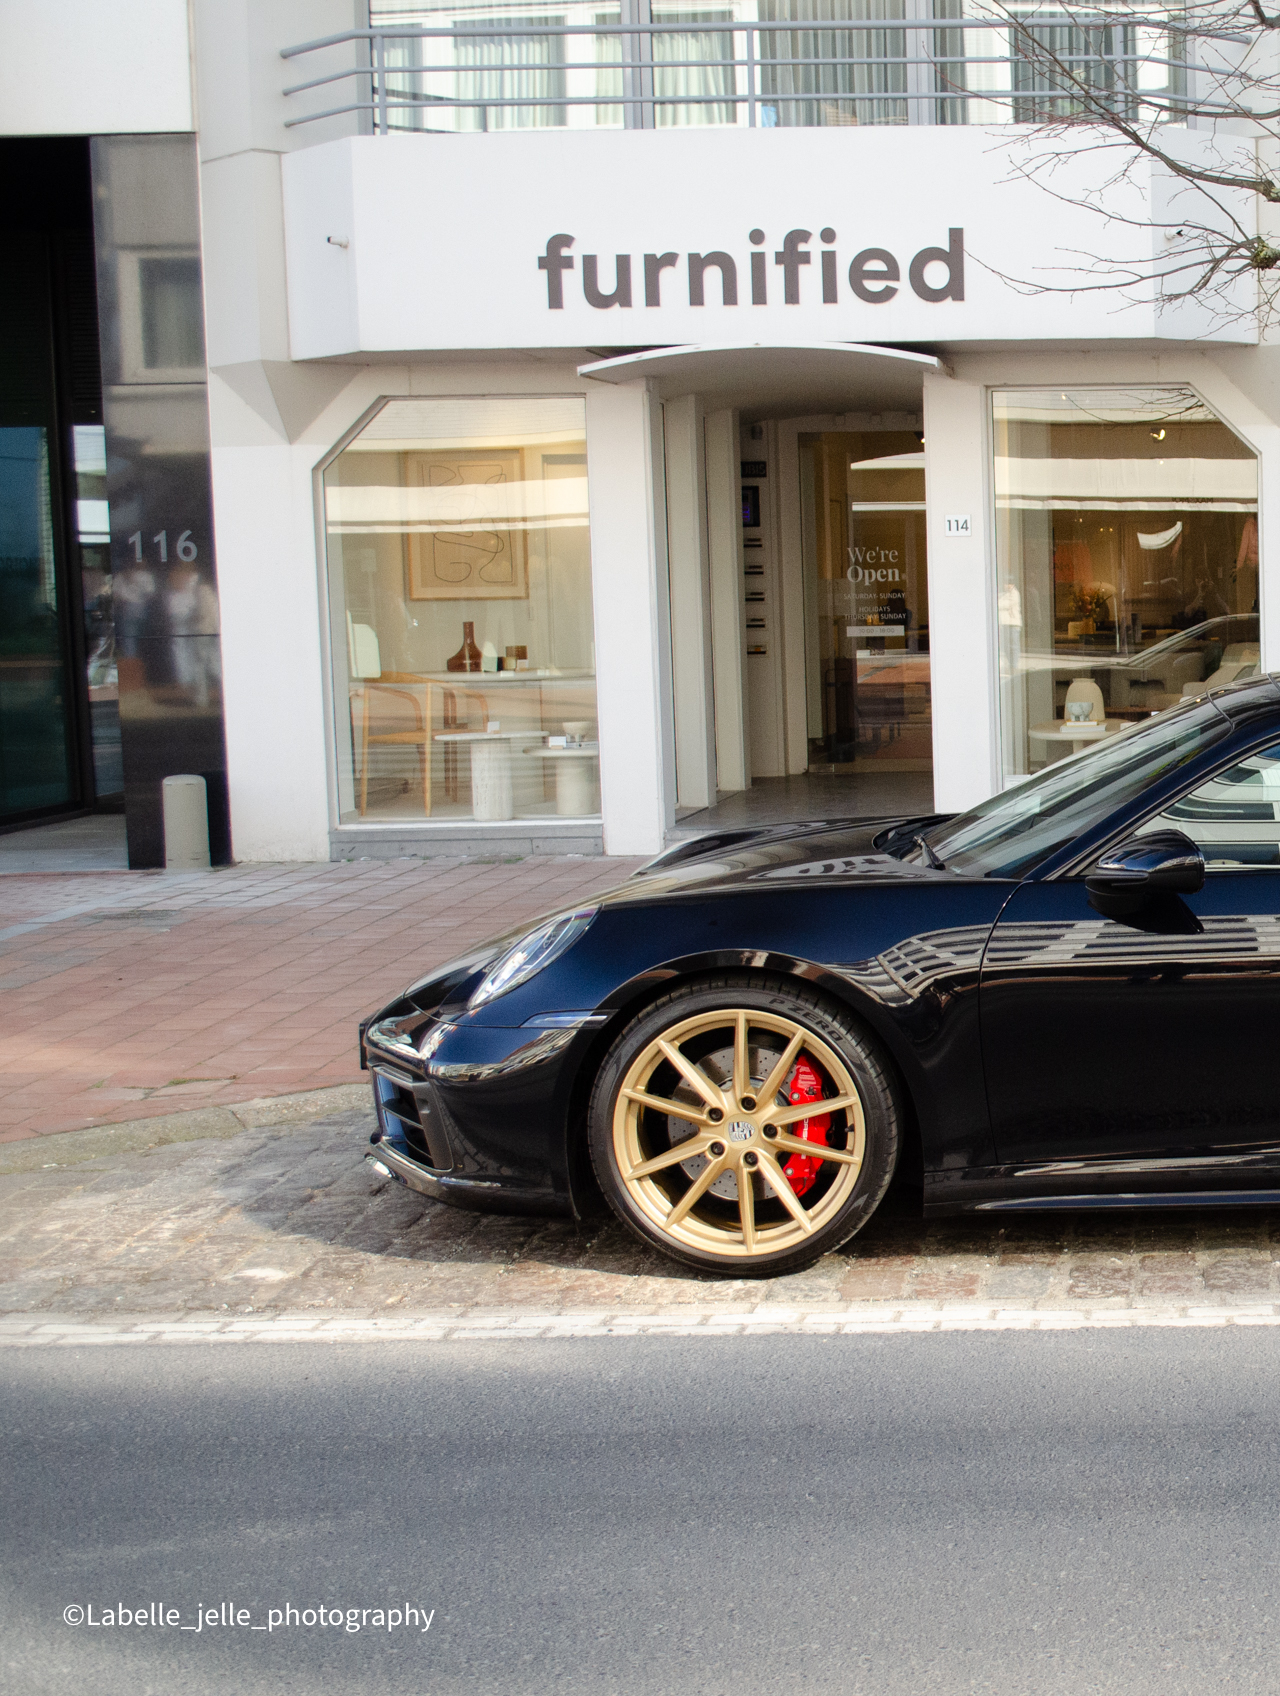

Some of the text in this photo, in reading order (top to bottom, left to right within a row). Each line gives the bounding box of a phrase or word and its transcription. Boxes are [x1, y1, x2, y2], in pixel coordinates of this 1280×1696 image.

[538, 227, 965, 309] furnified
[947, 519, 969, 531] 114
[128, 529, 198, 563] 116
[847, 546, 899, 563] We're
[846, 565, 900, 586] Open
[788, 1003, 843, 1041] ZERO
